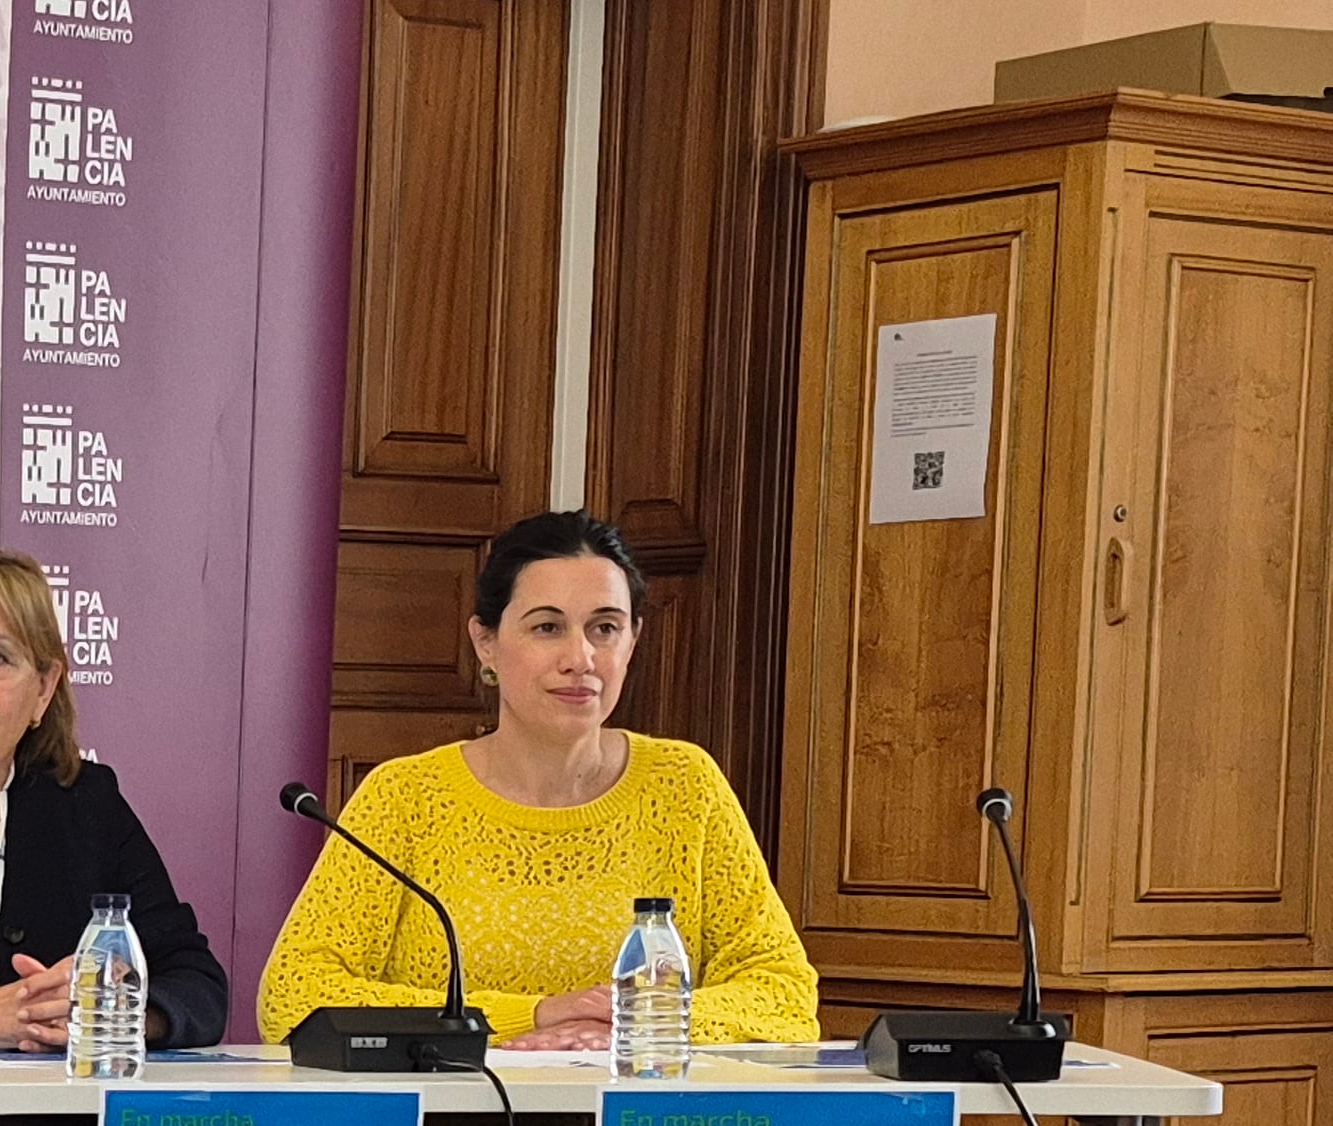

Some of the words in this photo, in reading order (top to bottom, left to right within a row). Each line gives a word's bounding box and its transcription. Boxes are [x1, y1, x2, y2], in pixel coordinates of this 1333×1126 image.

[33, 20, 133, 44] AYUNTAMIENTO
[87, 107, 118, 134] PA
[85, 133, 132, 161] LEN
[84, 160, 126, 188] CIA
[27, 187, 126, 206] AYUNTAMIENTO
[81, 269, 111, 295] PA
[80, 296, 126, 322] LEN
[79, 322, 120, 348] CIA
[22, 349, 120, 368] AYUNTAMIENTO
[77, 431, 107, 456] PA
[76, 457, 122, 482] LEN
[76, 482, 117, 507] CIA
[20, 509, 117, 527] AYUNTAMIENTO
[74, 590, 104, 615] PA
[74, 616, 119, 641] LEN
[72, 641, 113, 666] CIA
